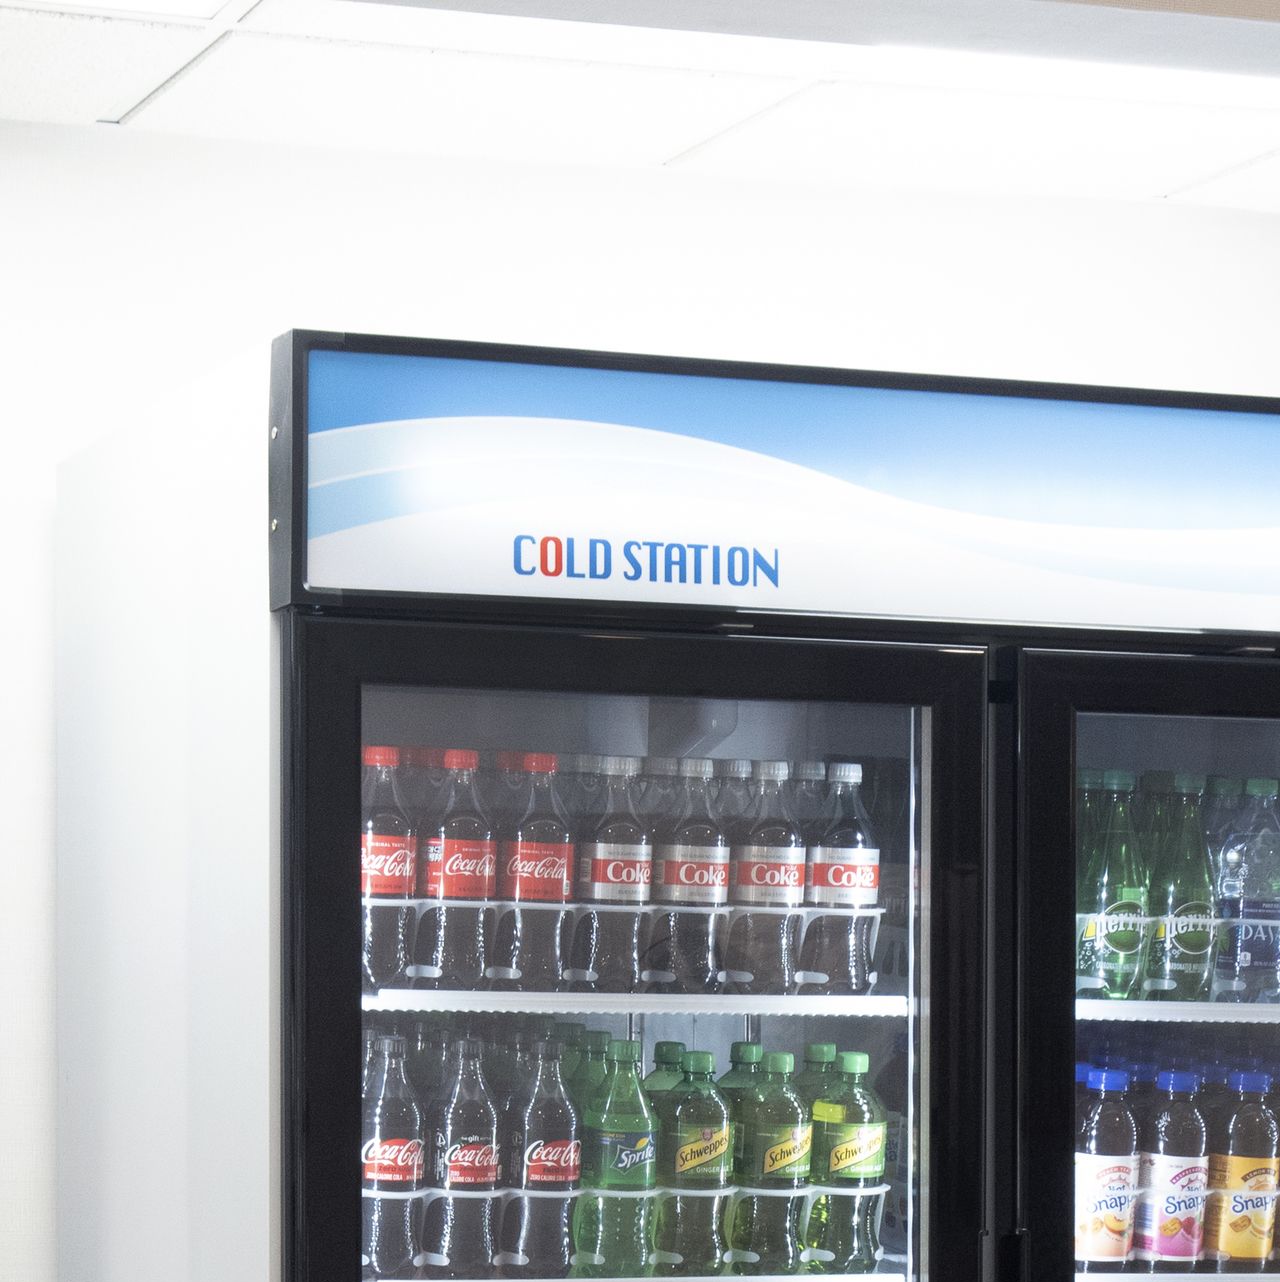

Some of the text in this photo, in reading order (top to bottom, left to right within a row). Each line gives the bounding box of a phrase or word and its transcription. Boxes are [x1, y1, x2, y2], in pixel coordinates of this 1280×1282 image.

[513, 535, 779, 588] COLD STATION
[507, 854, 567, 879] Coca-Cola
[607, 861, 651, 882] Coke
[751, 864, 799, 885] Coke
[827, 865, 874, 887] Coke
